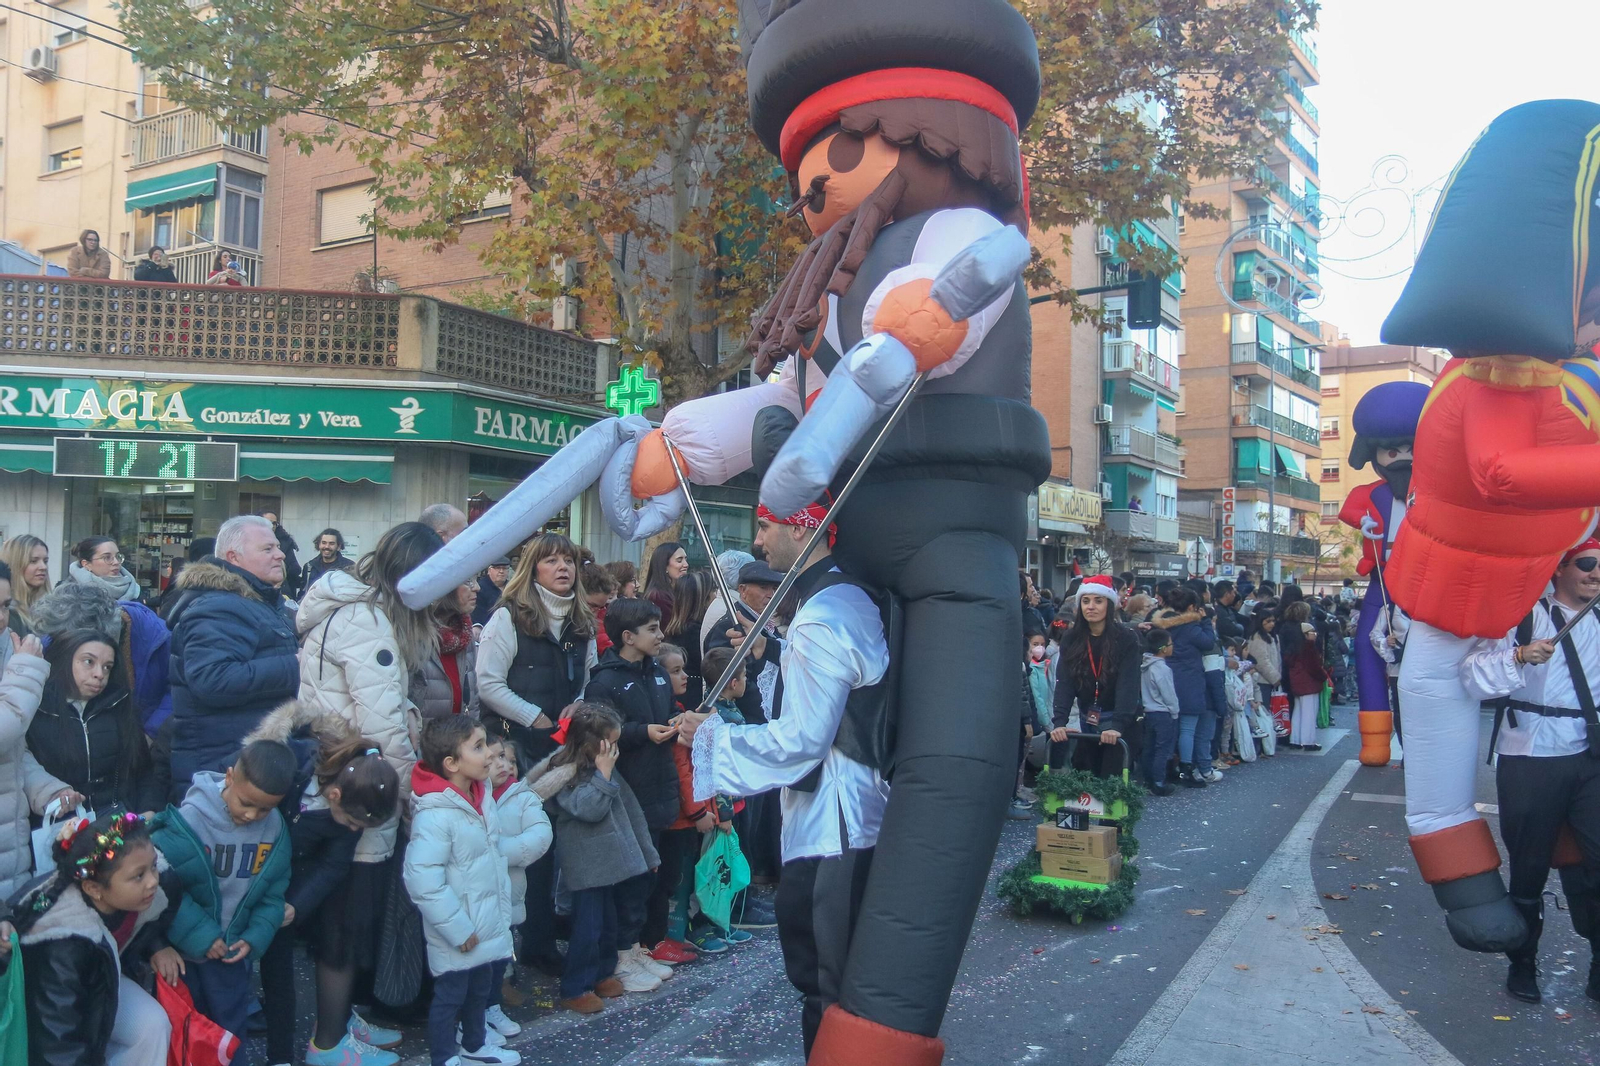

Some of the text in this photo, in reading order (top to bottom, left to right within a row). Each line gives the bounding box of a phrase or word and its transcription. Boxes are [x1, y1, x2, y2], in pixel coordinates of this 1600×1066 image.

[200, 407, 362, 429] González y Vera
[474, 406, 588, 447] FARMAC
[99, 440, 196, 479] 17 21
